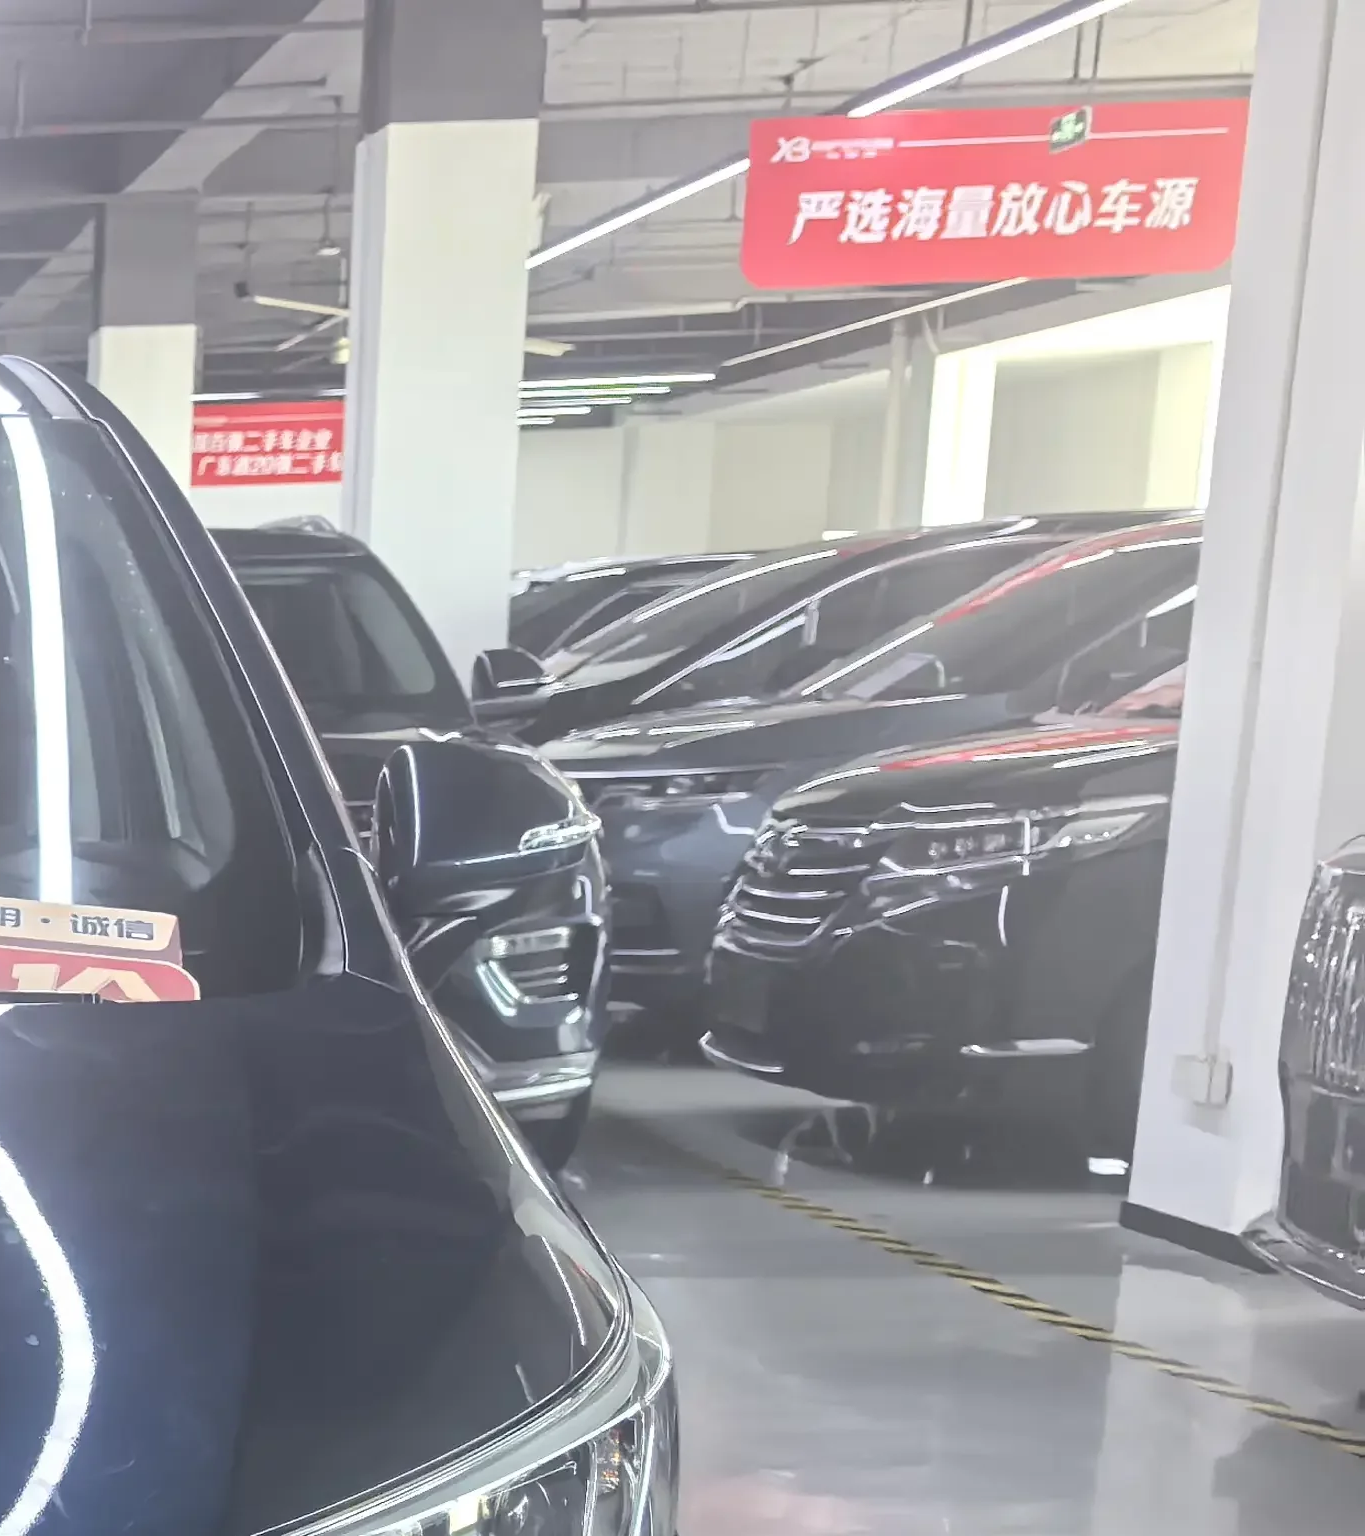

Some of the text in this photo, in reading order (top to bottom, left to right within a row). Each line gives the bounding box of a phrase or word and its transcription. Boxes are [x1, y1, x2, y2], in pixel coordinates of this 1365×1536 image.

[787, 177, 1199, 245] 严选海量放心车源
